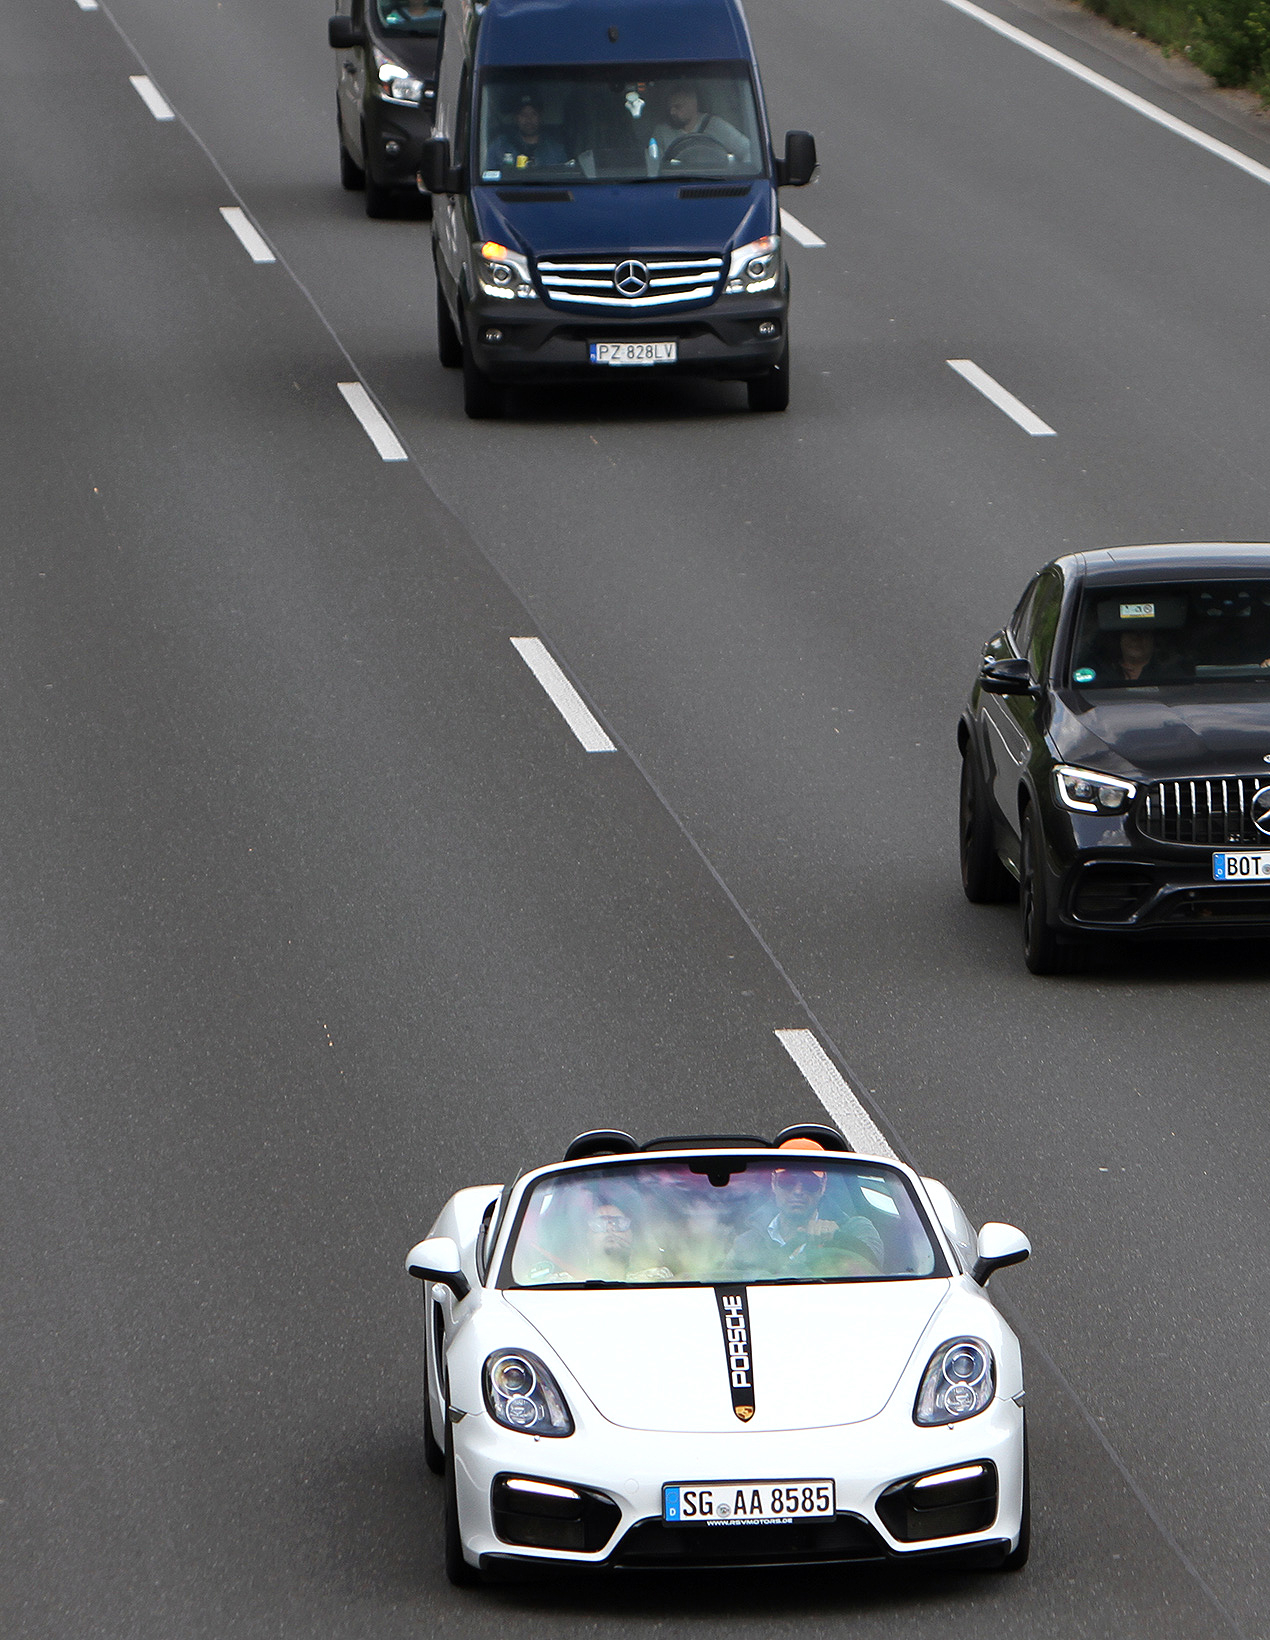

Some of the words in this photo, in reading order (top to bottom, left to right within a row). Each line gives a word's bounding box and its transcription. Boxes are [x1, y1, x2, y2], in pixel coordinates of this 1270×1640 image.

[599, 344, 621, 360] PZ
[626, 343, 674, 360] 828LV
[1227, 856, 1262, 876] BOT
[722, 1295, 752, 1388] PORSCHE
[669, 1508, 677, 1516] D
[683, 1490, 713, 1517] SG
[733, 1489, 764, 1516] AA
[770, 1486, 830, 1514] 8585
